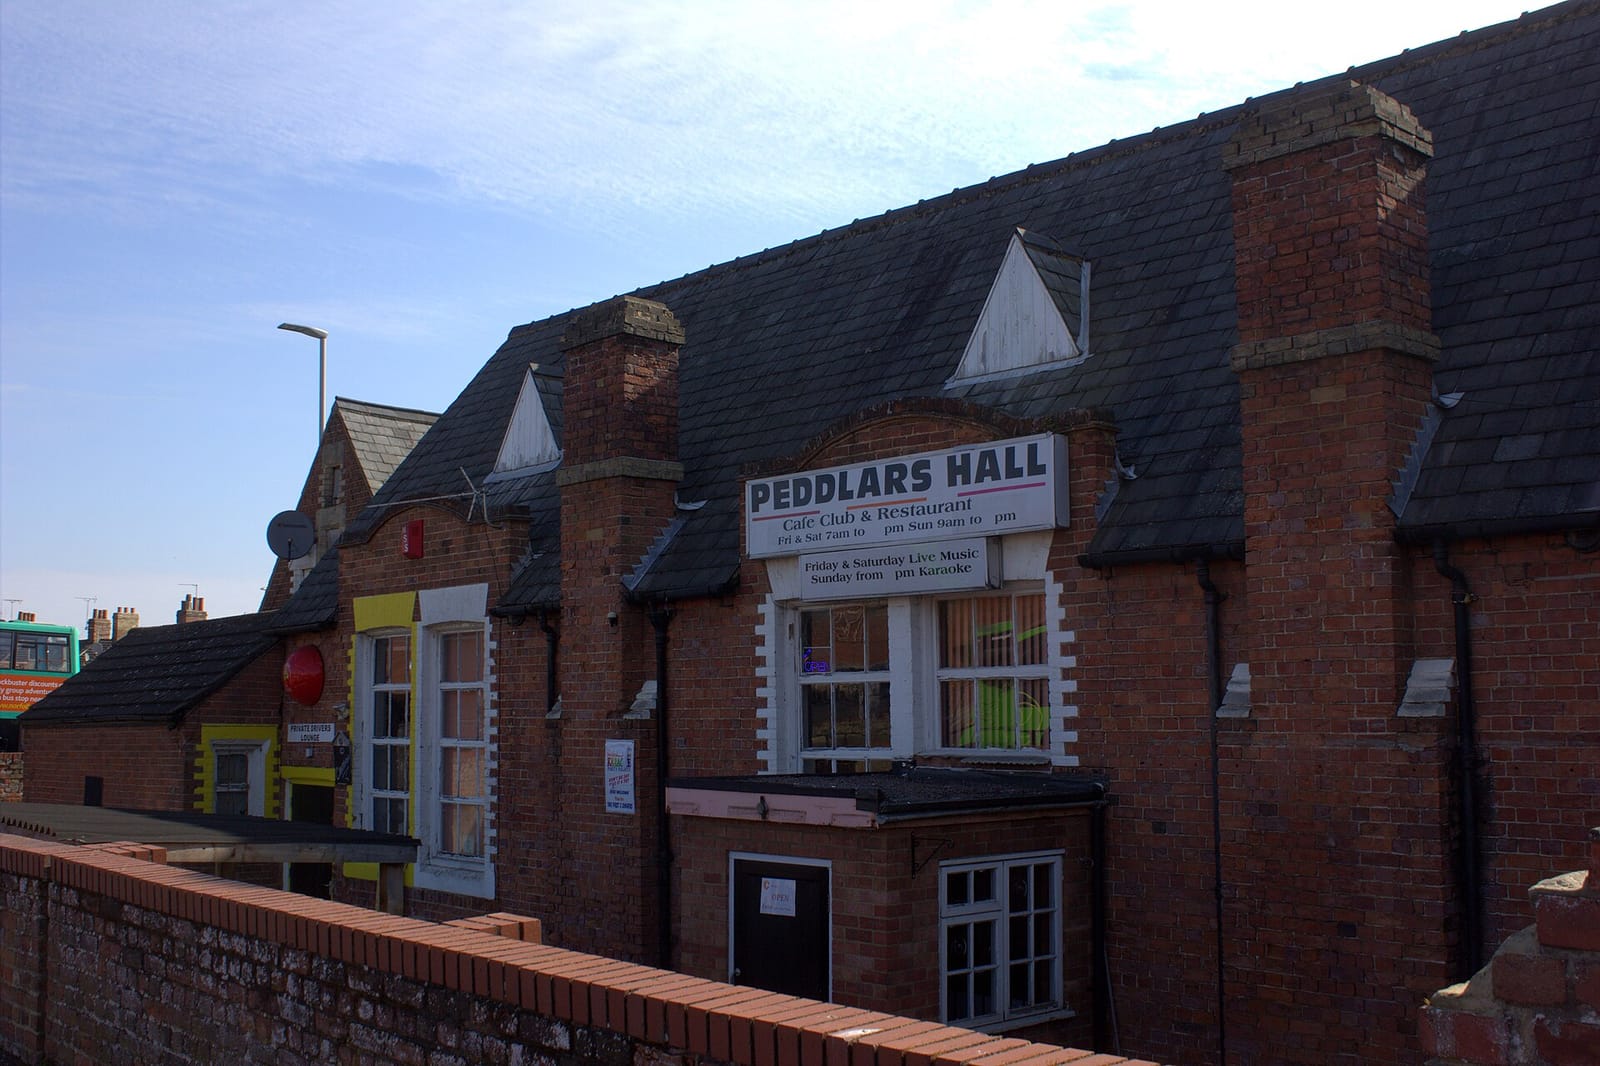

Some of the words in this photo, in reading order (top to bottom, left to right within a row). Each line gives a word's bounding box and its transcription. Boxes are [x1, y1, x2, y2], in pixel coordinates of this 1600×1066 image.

[751, 459, 932, 513] PEDDLARS
[946, 443, 1047, 488] HALL
[778, 535, 792, 546] Fri
[794, 534, 802, 543] &
[805, 531, 822, 543] Sat
[825, 529, 850, 540] 7am
[853, 528, 865, 537] to
[884, 524, 904, 536] pm
[908, 520, 933, 531] Sun
[937, 517, 965, 529] 9am
[969, 515, 982, 525] to
[994, 511, 1017, 525] pm
[783, 516, 815, 532] Cafe
[820, 511, 855, 527] Club
[860, 510, 872, 522] &
[877, 497, 973, 520] Restaurant
[805, 561, 839, 573] Friday
[841, 559, 850, 569] &
[852, 554, 905, 569] Saturday
[909, 552, 936, 564] Live
[940, 548, 979, 562] Music
[811, 573, 852, 585] Sunday
[856, 570, 884, 581] from
[895, 568, 915, 580] pm
[919, 563, 972, 577] Karaoke
[28, 680, 57, 688] discounts
